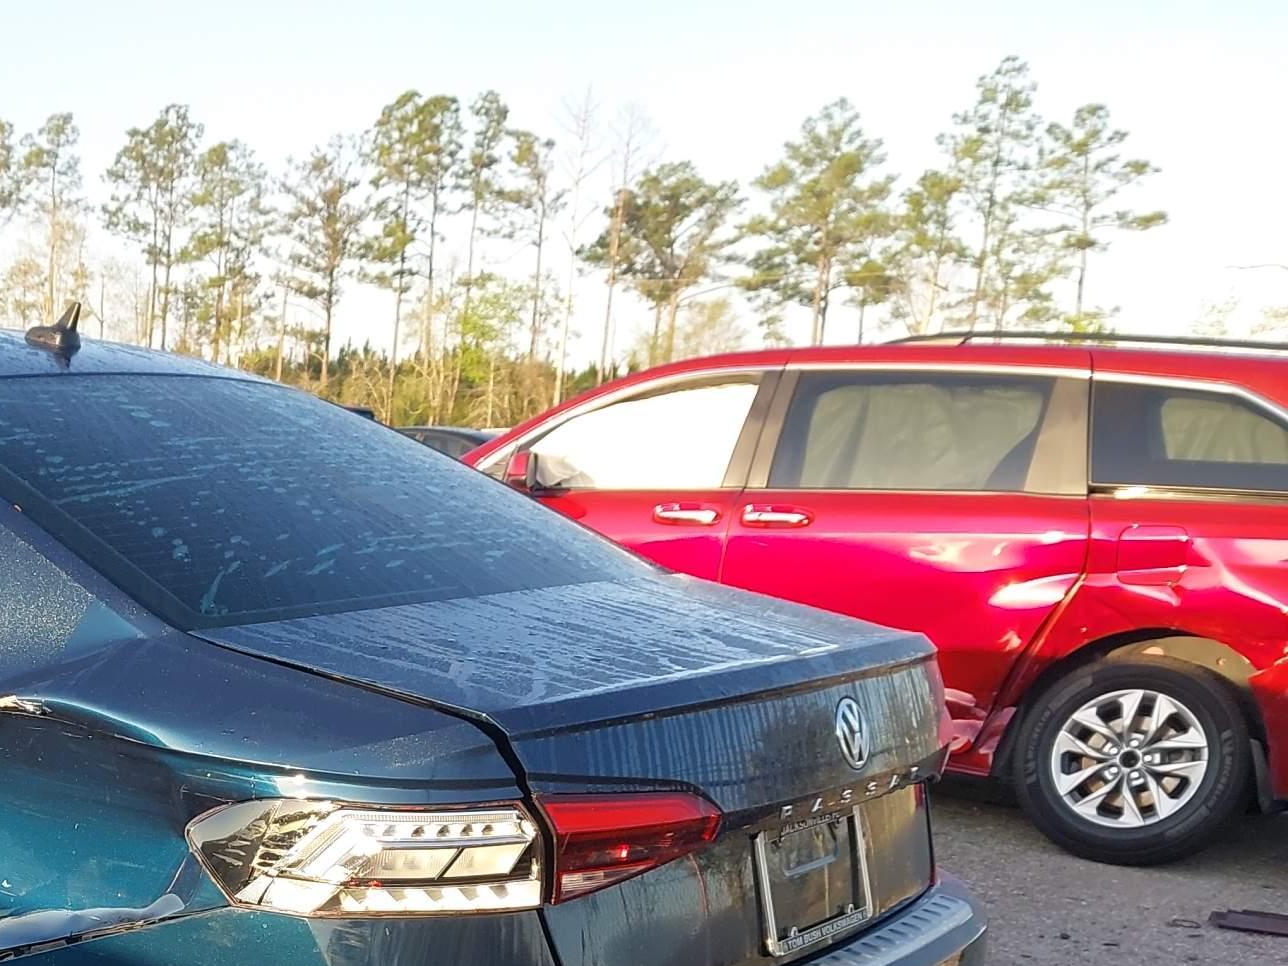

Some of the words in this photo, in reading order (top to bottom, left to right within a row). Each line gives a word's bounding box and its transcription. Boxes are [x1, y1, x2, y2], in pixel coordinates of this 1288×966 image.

[780, 766, 920, 819] PASSAT
[787, 935, 804, 951] TOM
[804, 928, 822, 944] BUSH
[822, 912, 864, 935] VOLKSWAGEN
